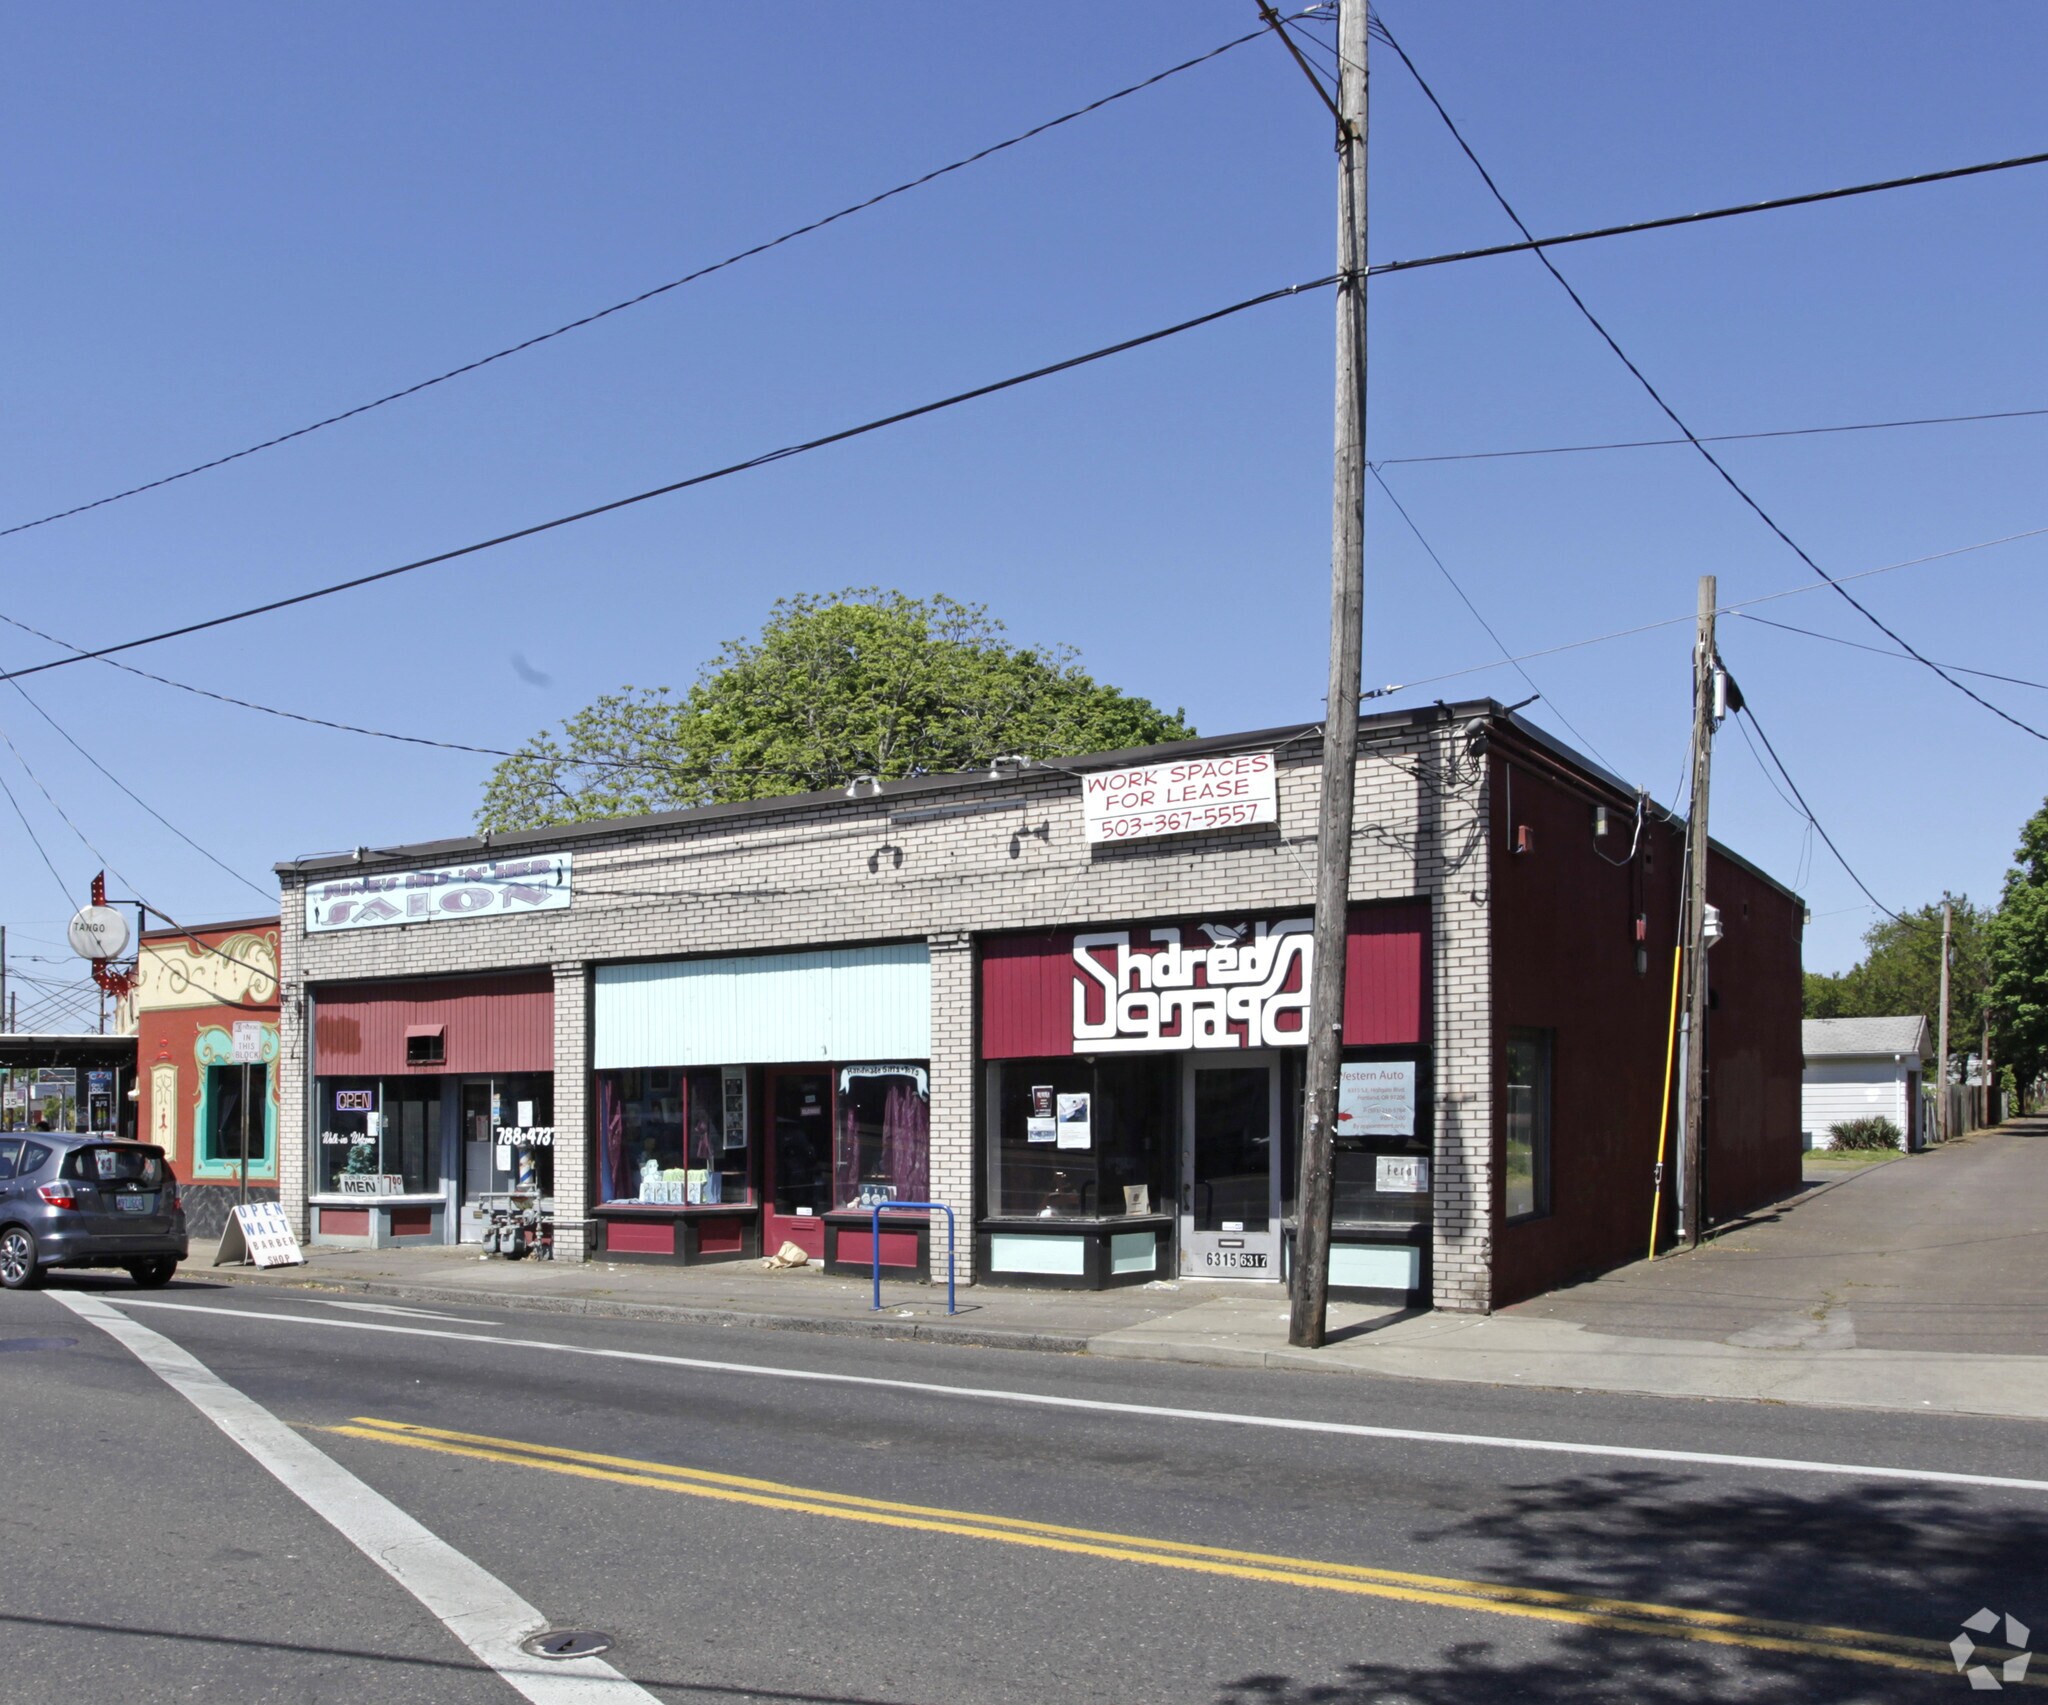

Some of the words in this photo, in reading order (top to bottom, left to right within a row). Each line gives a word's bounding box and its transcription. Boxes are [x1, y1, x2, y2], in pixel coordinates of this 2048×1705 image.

[1088, 771, 1158, 793] WORK
[1170, 755, 1269, 783] SPACES
[1106, 790, 1155, 811] FOR
[1167, 779, 1250, 803] LEASE
[1102, 803, 1258, 839] 503-367-5557
[320, 876, 399, 901] JUNE'S
[405, 871, 452, 889] HIS
[494, 859, 551, 880] HER
[321, 879, 553, 926] SALON
[74, 922, 105, 933] TANGO
[239, 1042, 255, 1050] THIS
[1379, 1070, 1404, 1080] Auto
[5, 1098, 17, 1106] 35
[339, 1093, 370, 1109] OPEN
[344, 1182, 376, 1193] MEN
[238, 1203, 283, 1218] OPEN
[243, 1220, 288, 1236] WALT
[253, 1236, 295, 1250] BARBER
[268, 1254, 290, 1265] SHOP
[1206, 1252, 1237, 1267] 6315
[1240, 1253, 1267, 1268] 6317
